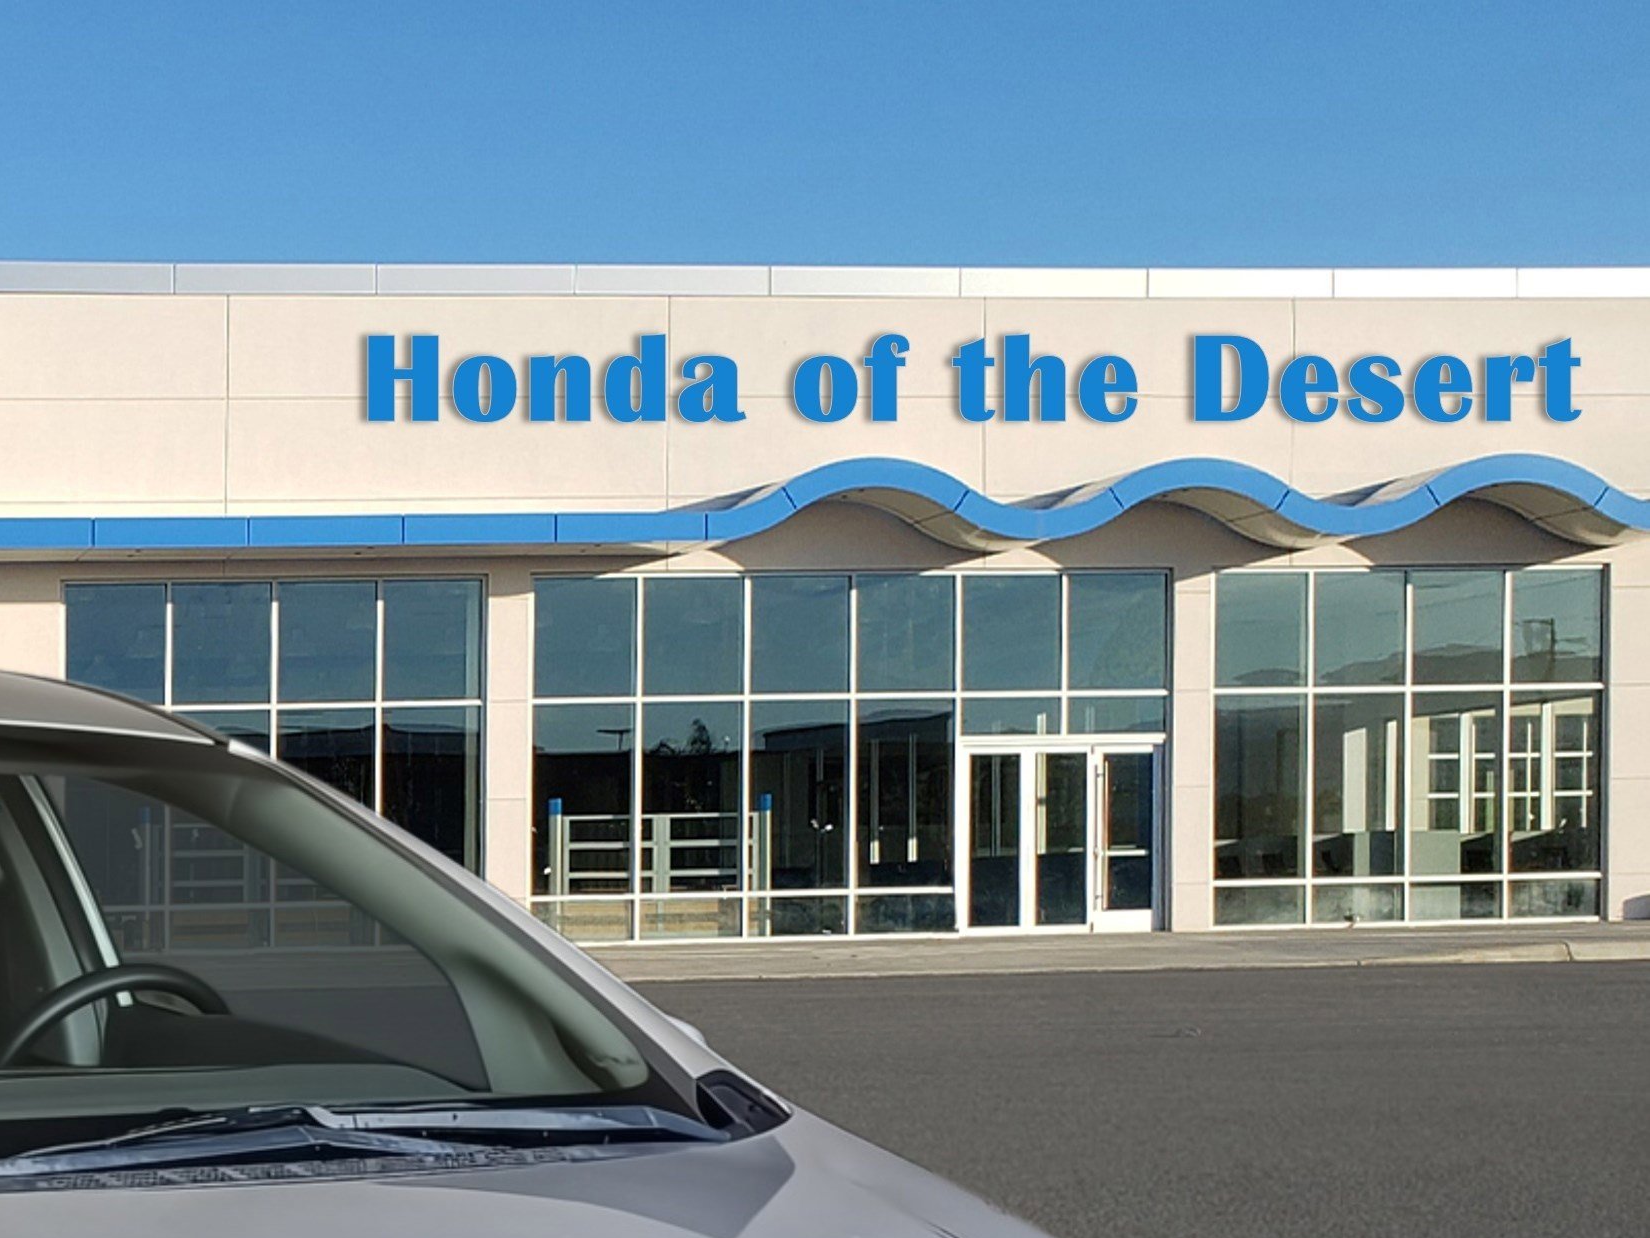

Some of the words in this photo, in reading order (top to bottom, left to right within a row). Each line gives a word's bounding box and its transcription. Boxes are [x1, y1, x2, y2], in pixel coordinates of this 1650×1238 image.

[366, 333, 746, 423] Honda
[793, 333, 910, 423] of
[951, 334, 1138, 423] the
[1193, 334, 1582, 423] Desert
